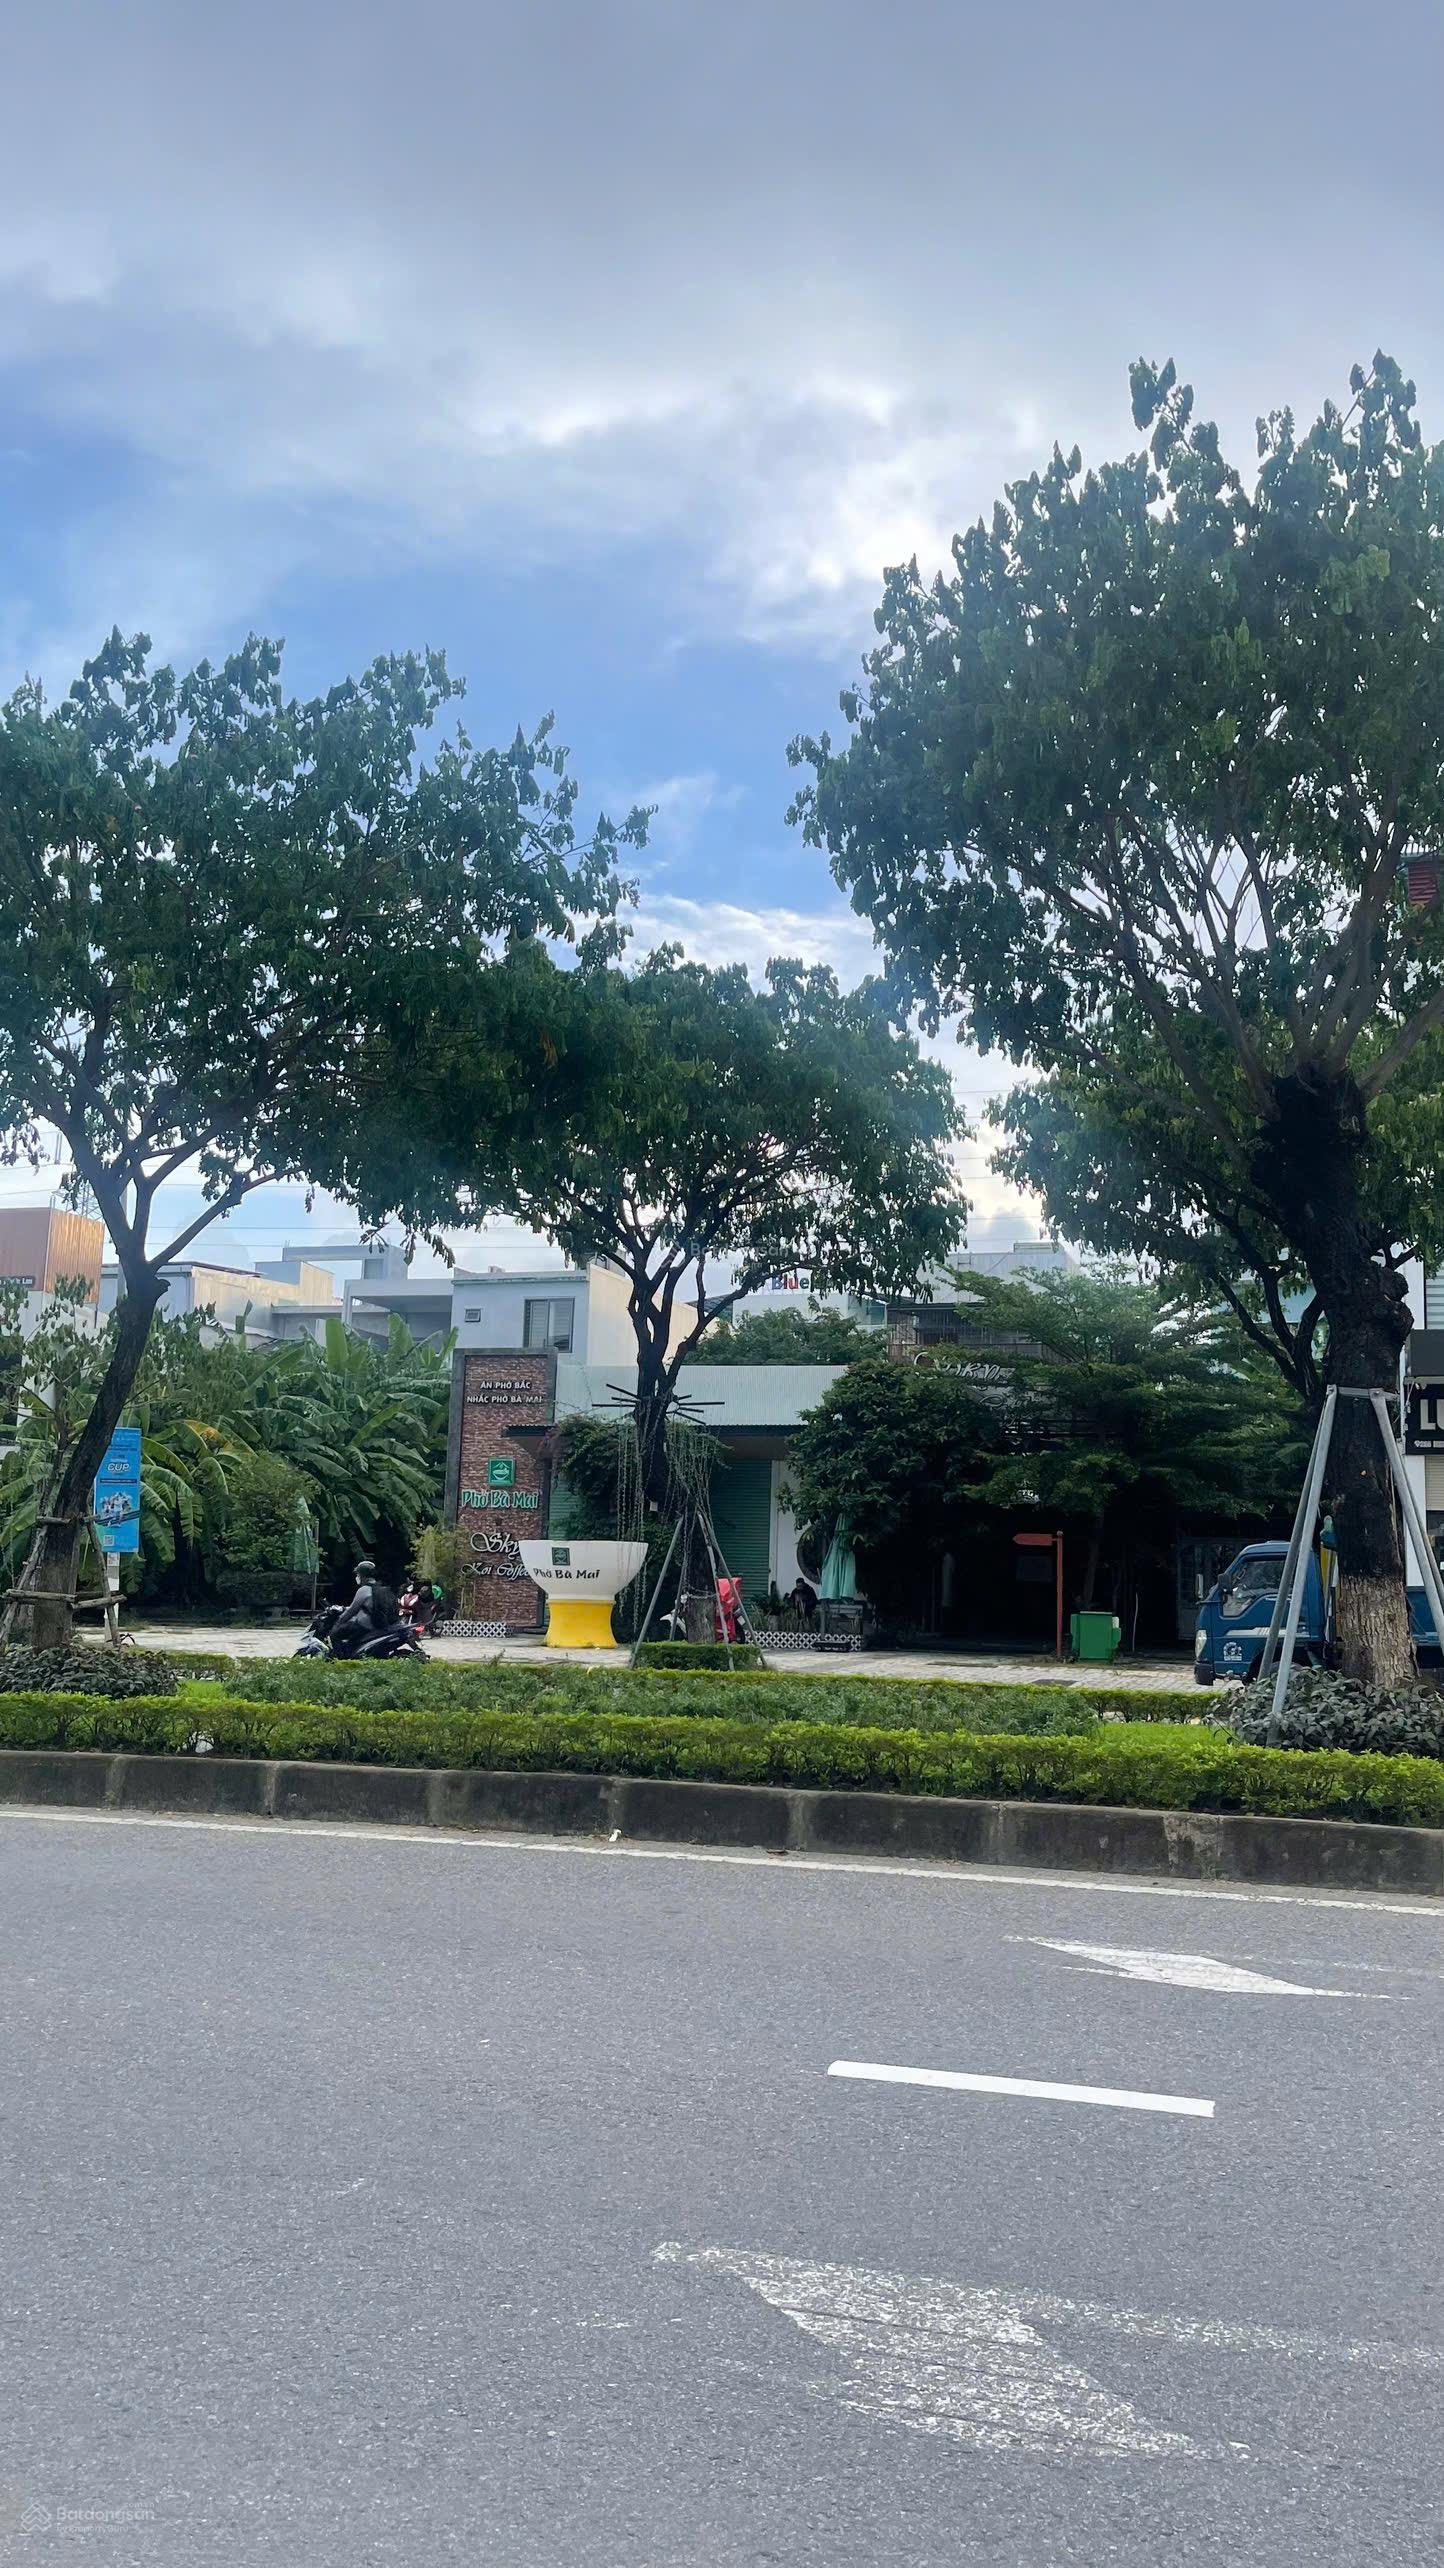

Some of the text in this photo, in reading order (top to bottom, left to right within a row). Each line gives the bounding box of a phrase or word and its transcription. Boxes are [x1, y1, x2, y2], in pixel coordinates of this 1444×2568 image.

[771, 1273, 809, 1290] Blue
[107, 1463, 130, 1471] CUP
[461, 1488, 539, 1509] Phở Bà Mai
[470, 1532, 520, 1559] Sky
[576, 1569, 601, 1579] Mai
